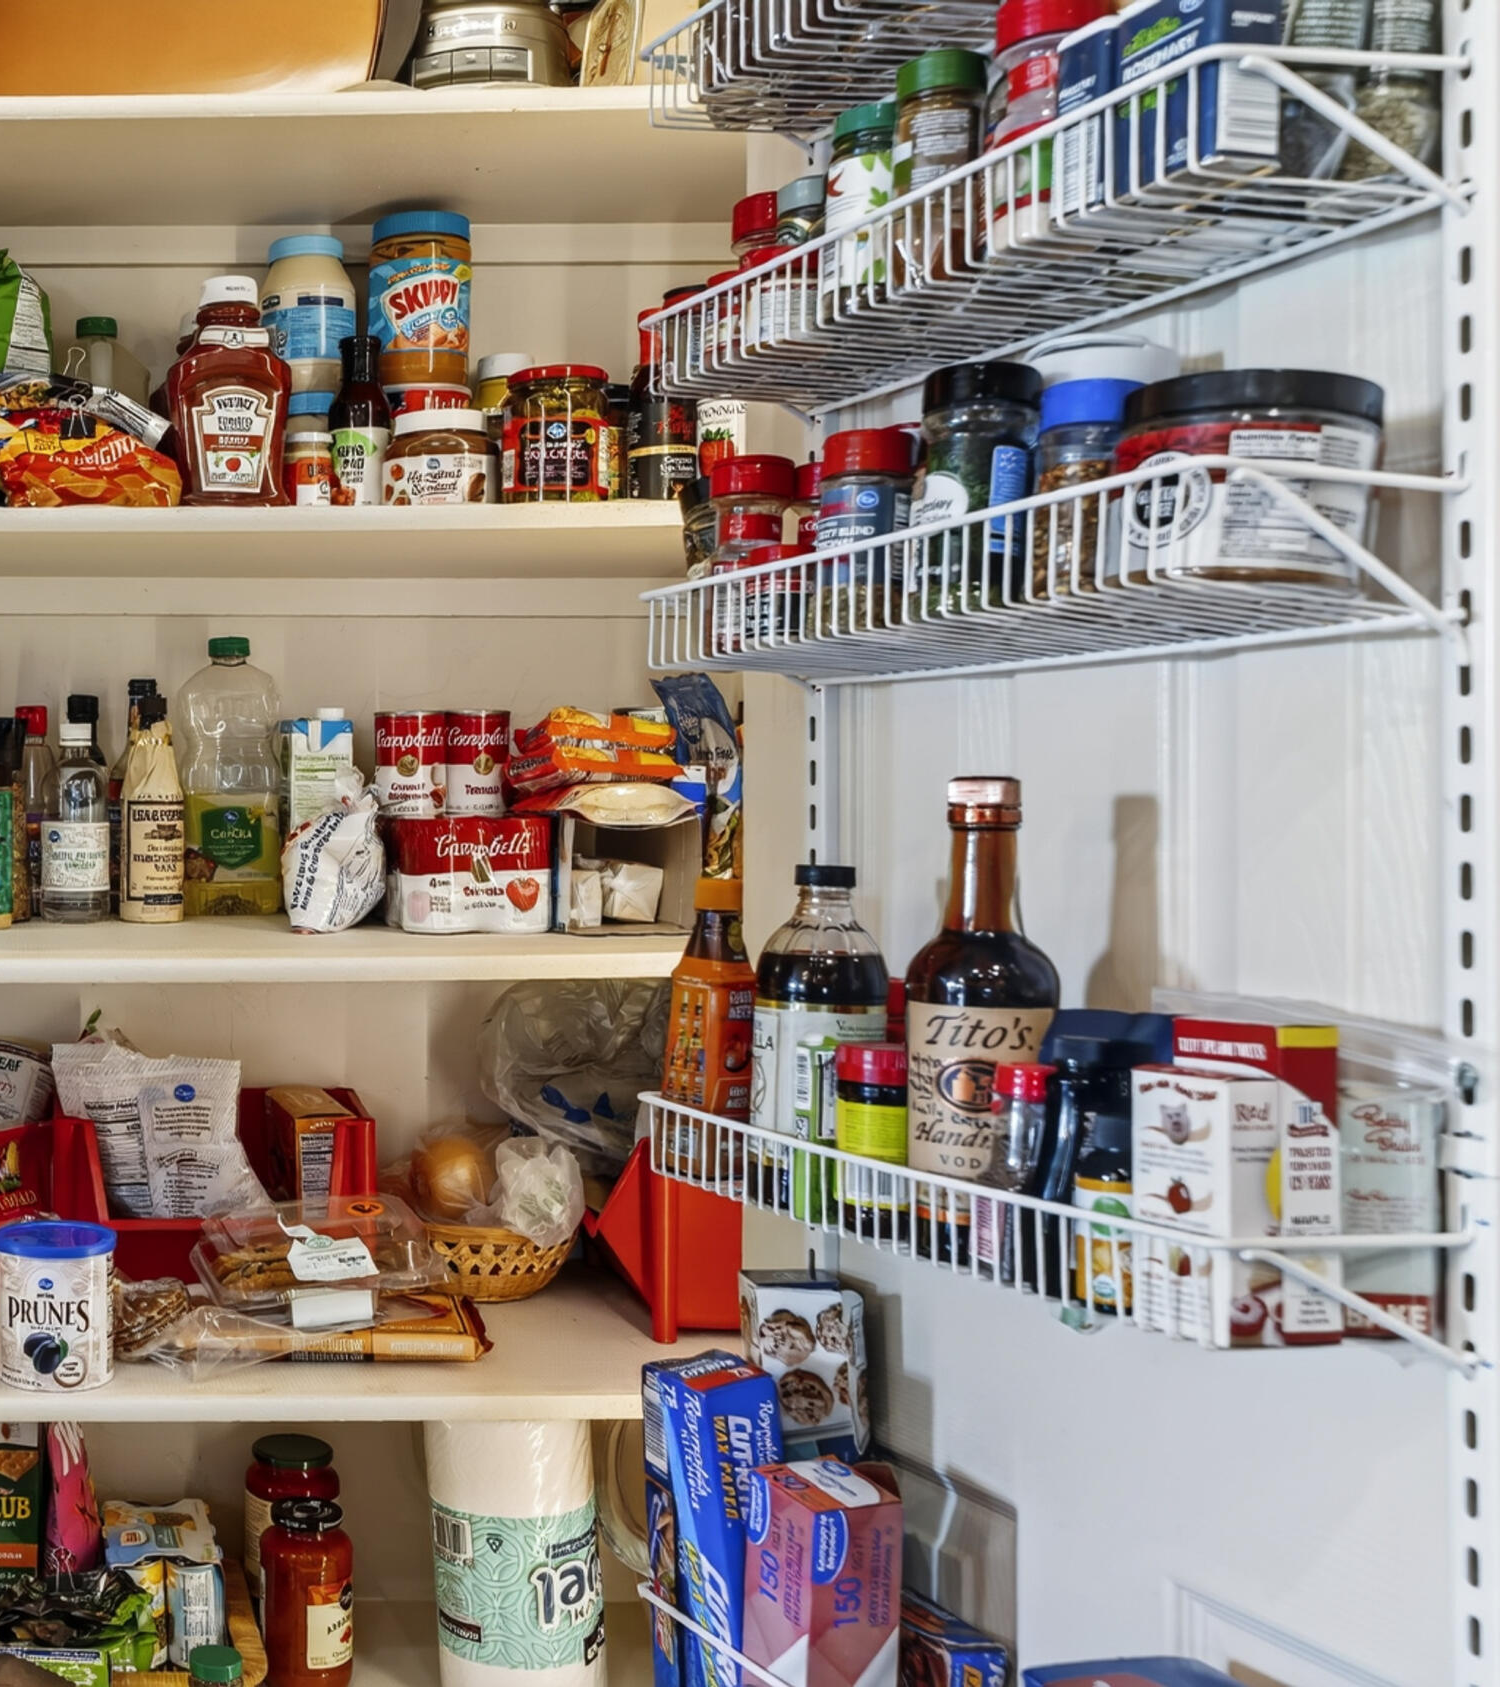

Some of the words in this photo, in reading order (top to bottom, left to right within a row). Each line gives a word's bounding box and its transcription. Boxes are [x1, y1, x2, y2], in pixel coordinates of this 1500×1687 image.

[8, 1295, 90, 1333] PRUNES
[713, 1415, 730, 1455] WAX
[719, 1462, 741, 1519] PAPER
[757, 1549, 781, 1603] 150
[834, 1577, 863, 1629] 150
